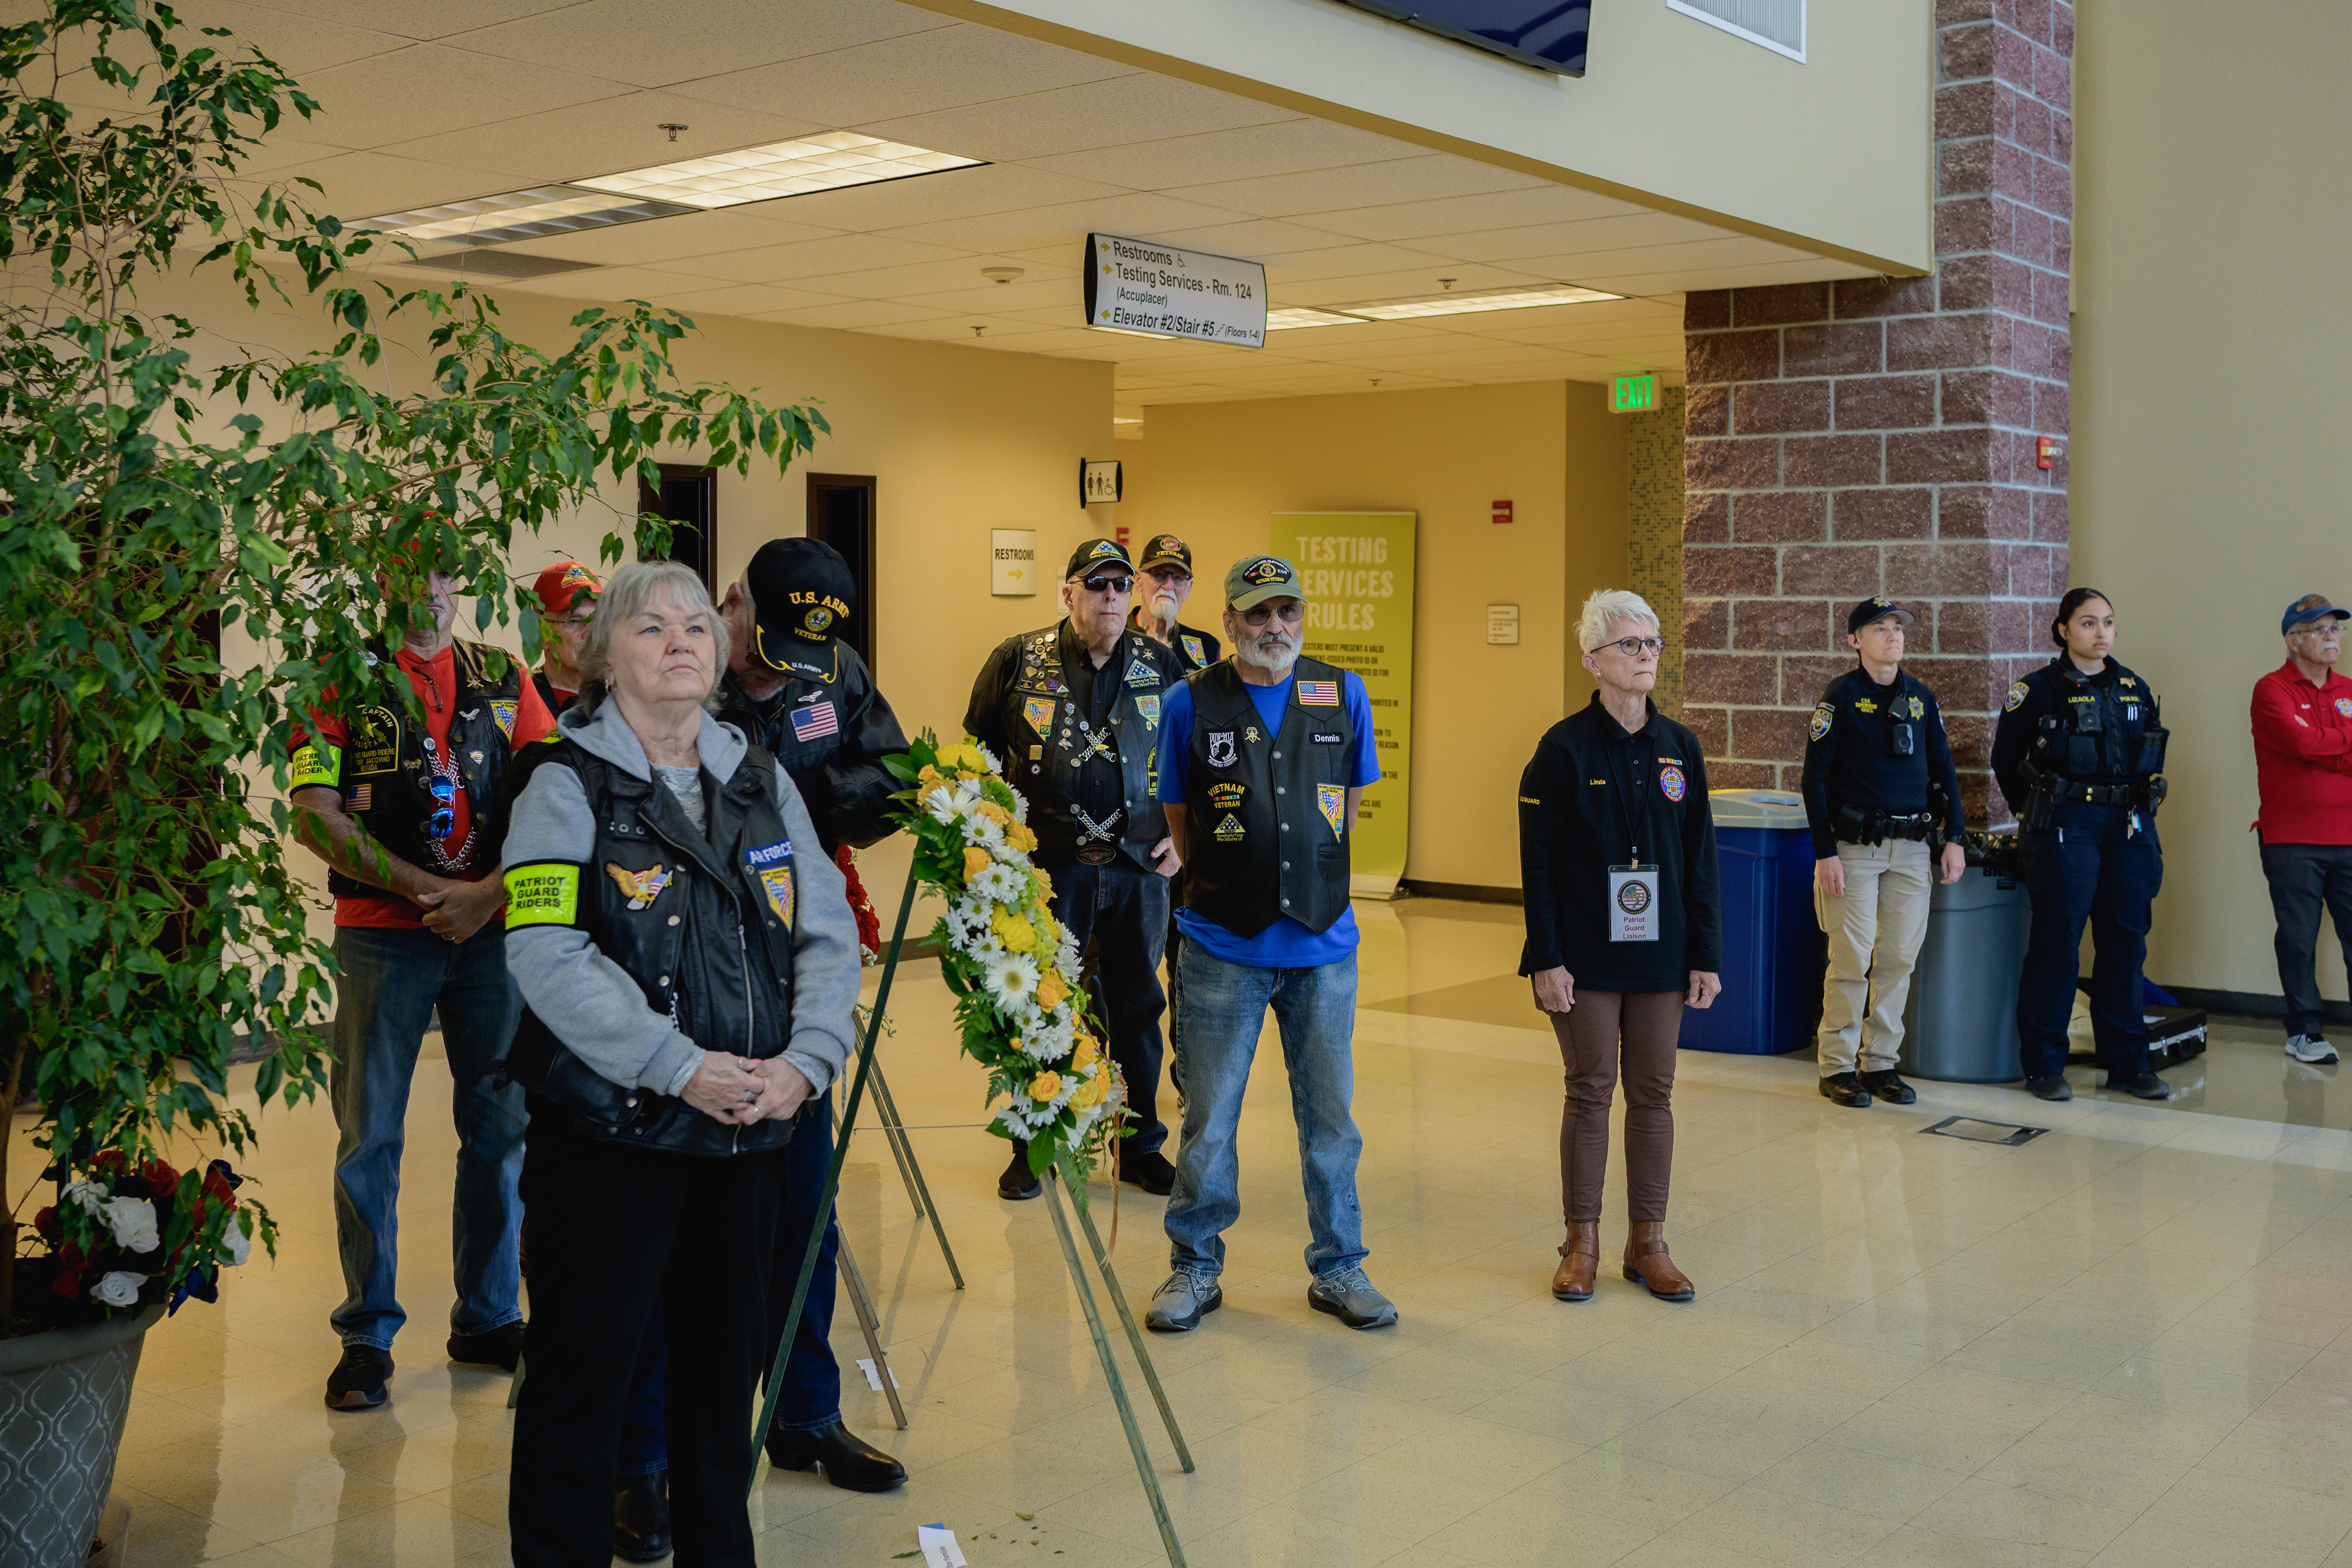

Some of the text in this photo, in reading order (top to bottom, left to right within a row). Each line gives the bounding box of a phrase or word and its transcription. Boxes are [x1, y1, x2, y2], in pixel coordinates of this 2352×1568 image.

[1113, 241, 1172, 265] Restrooms
[1115, 262, 1155, 288] Testing
[1159, 270, 1203, 292] Services
[1213, 279, 1232, 296] Rm.
[1235, 283, 1251, 299] 124
[1117, 286, 1167, 309] (Accuplacer)
[1113, 307, 1260, 342] Elevator #2/Stair #5 (Floors 1-4)
[1617, 376, 1653, 409] EXIT
[996, 548, 1034, 560] RESTROOMS
[1156, 550, 1184, 560] VETERAN
[1297, 536, 1387, 565] TESTING
[789, 591, 850, 618] U.S. ARMY
[1307, 602, 1375, 631] RULES
[794, 627, 827, 641] VETERAN
[1127, 663, 1153, 676] PATRIOT GUARD
[362, 708, 394, 728] CAPTAIN
[1378, 741, 1398, 749] REASON
[296, 753, 317, 763] PATRI
[296, 760, 319, 769] GUAR
[366, 756, 390, 765] JACOVINO
[360, 764, 378, 772] NEVADA
[1207, 783, 1245, 797] VIETNAM
[1214, 800, 1240, 808] VETERAN
[1219, 816, 1241, 829] PATRIOT GUARD
[762, 841, 793, 861] FORCE
[514, 877, 565, 889] PATRIOT
[518, 887, 559, 899] GUARD
[1624, 892, 1645, 901] 989
[516, 898, 560, 910] RIDERS
